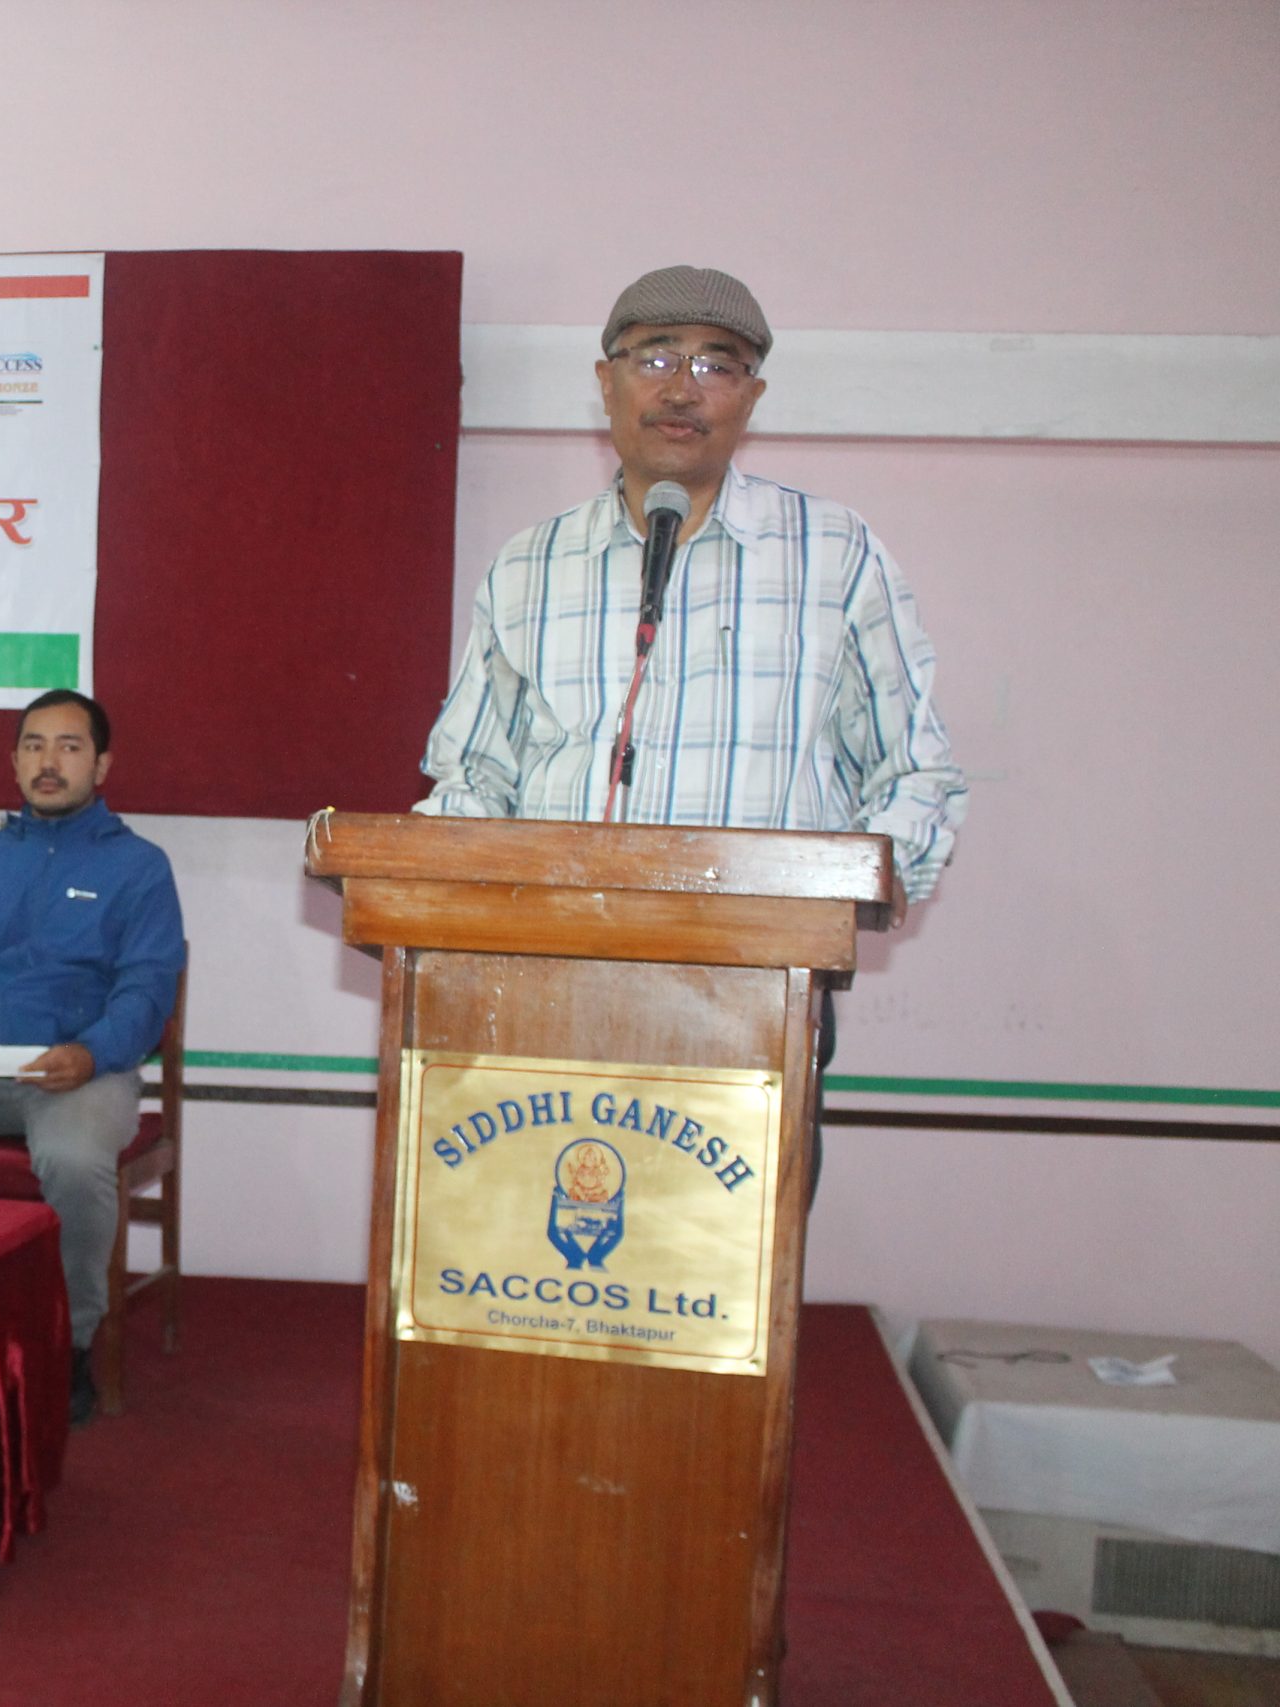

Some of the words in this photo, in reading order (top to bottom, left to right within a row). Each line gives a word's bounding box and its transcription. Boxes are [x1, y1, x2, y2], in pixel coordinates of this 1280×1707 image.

[433, 1091, 572, 1169] SIDDHI
[591, 1092, 755, 1194] GANESH
[438, 1268, 631, 1312] SACCOS
[648, 1288, 730, 1320] Ltd.
[488, 1310, 582, 1335] Chorcha-7,
[586, 1319, 676, 1343] Bhaktapur
